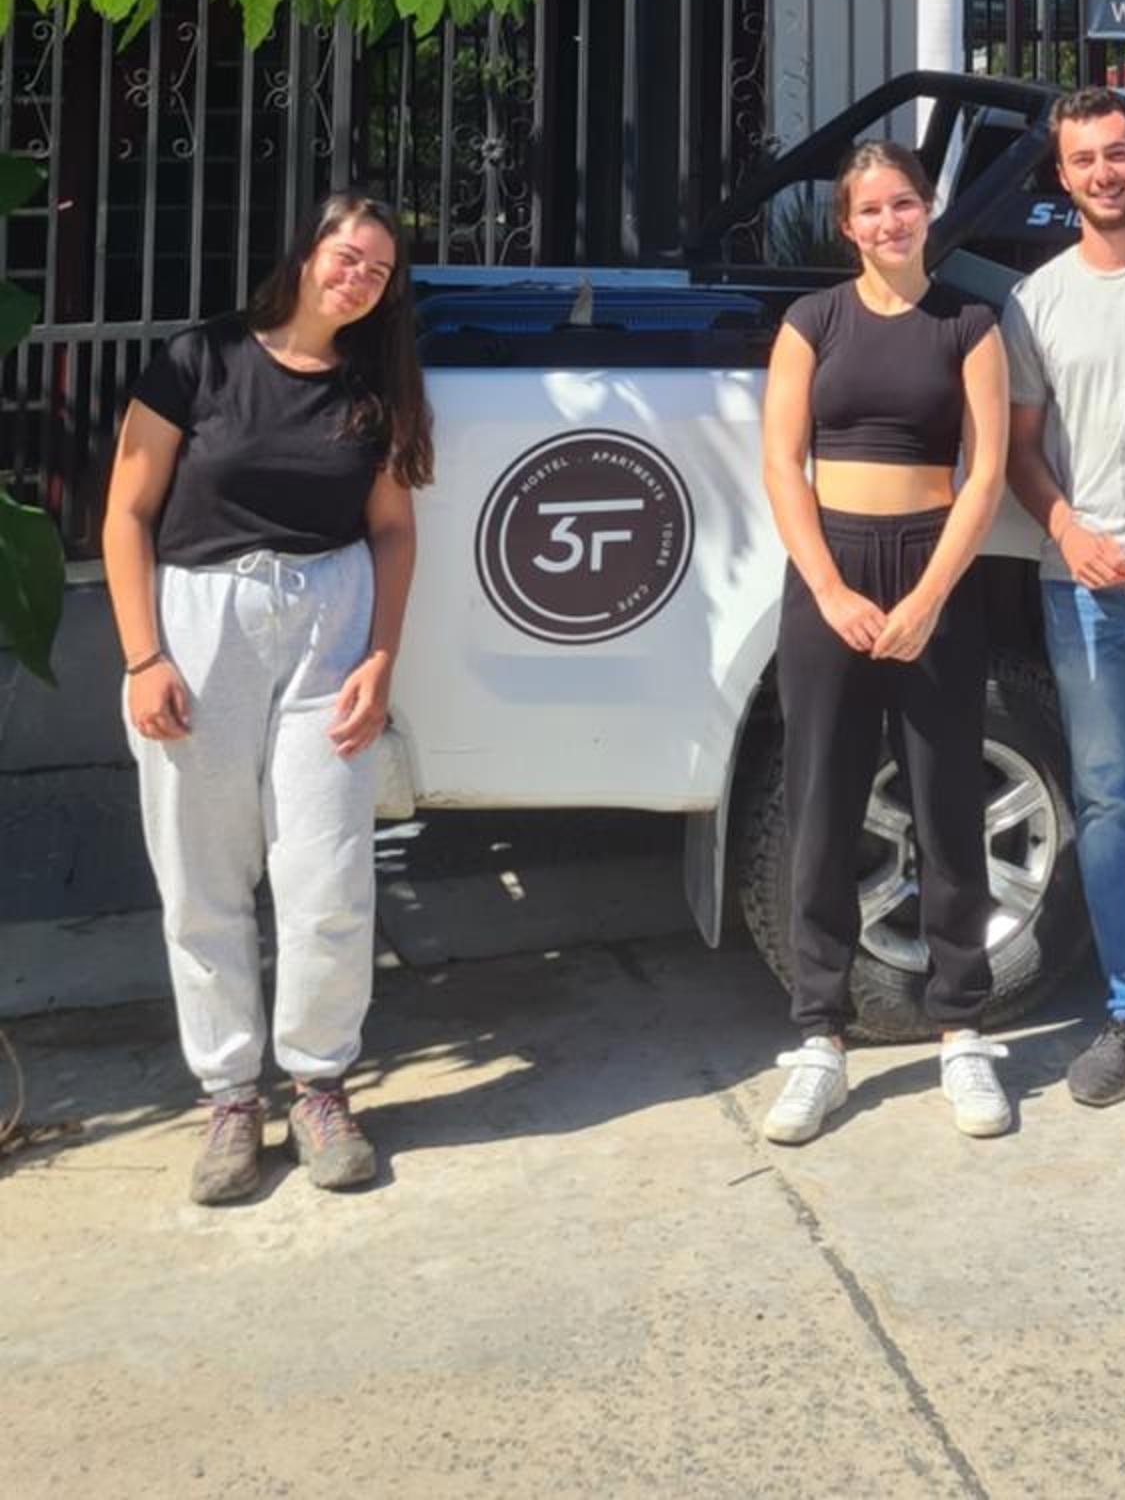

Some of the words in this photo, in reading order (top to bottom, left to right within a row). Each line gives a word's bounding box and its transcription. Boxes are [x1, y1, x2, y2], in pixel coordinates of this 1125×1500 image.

[521, 456, 569, 493] HOSTEL
[592, 452, 666, 501] APARTMENTS
[532, 499, 644, 573] 3F
